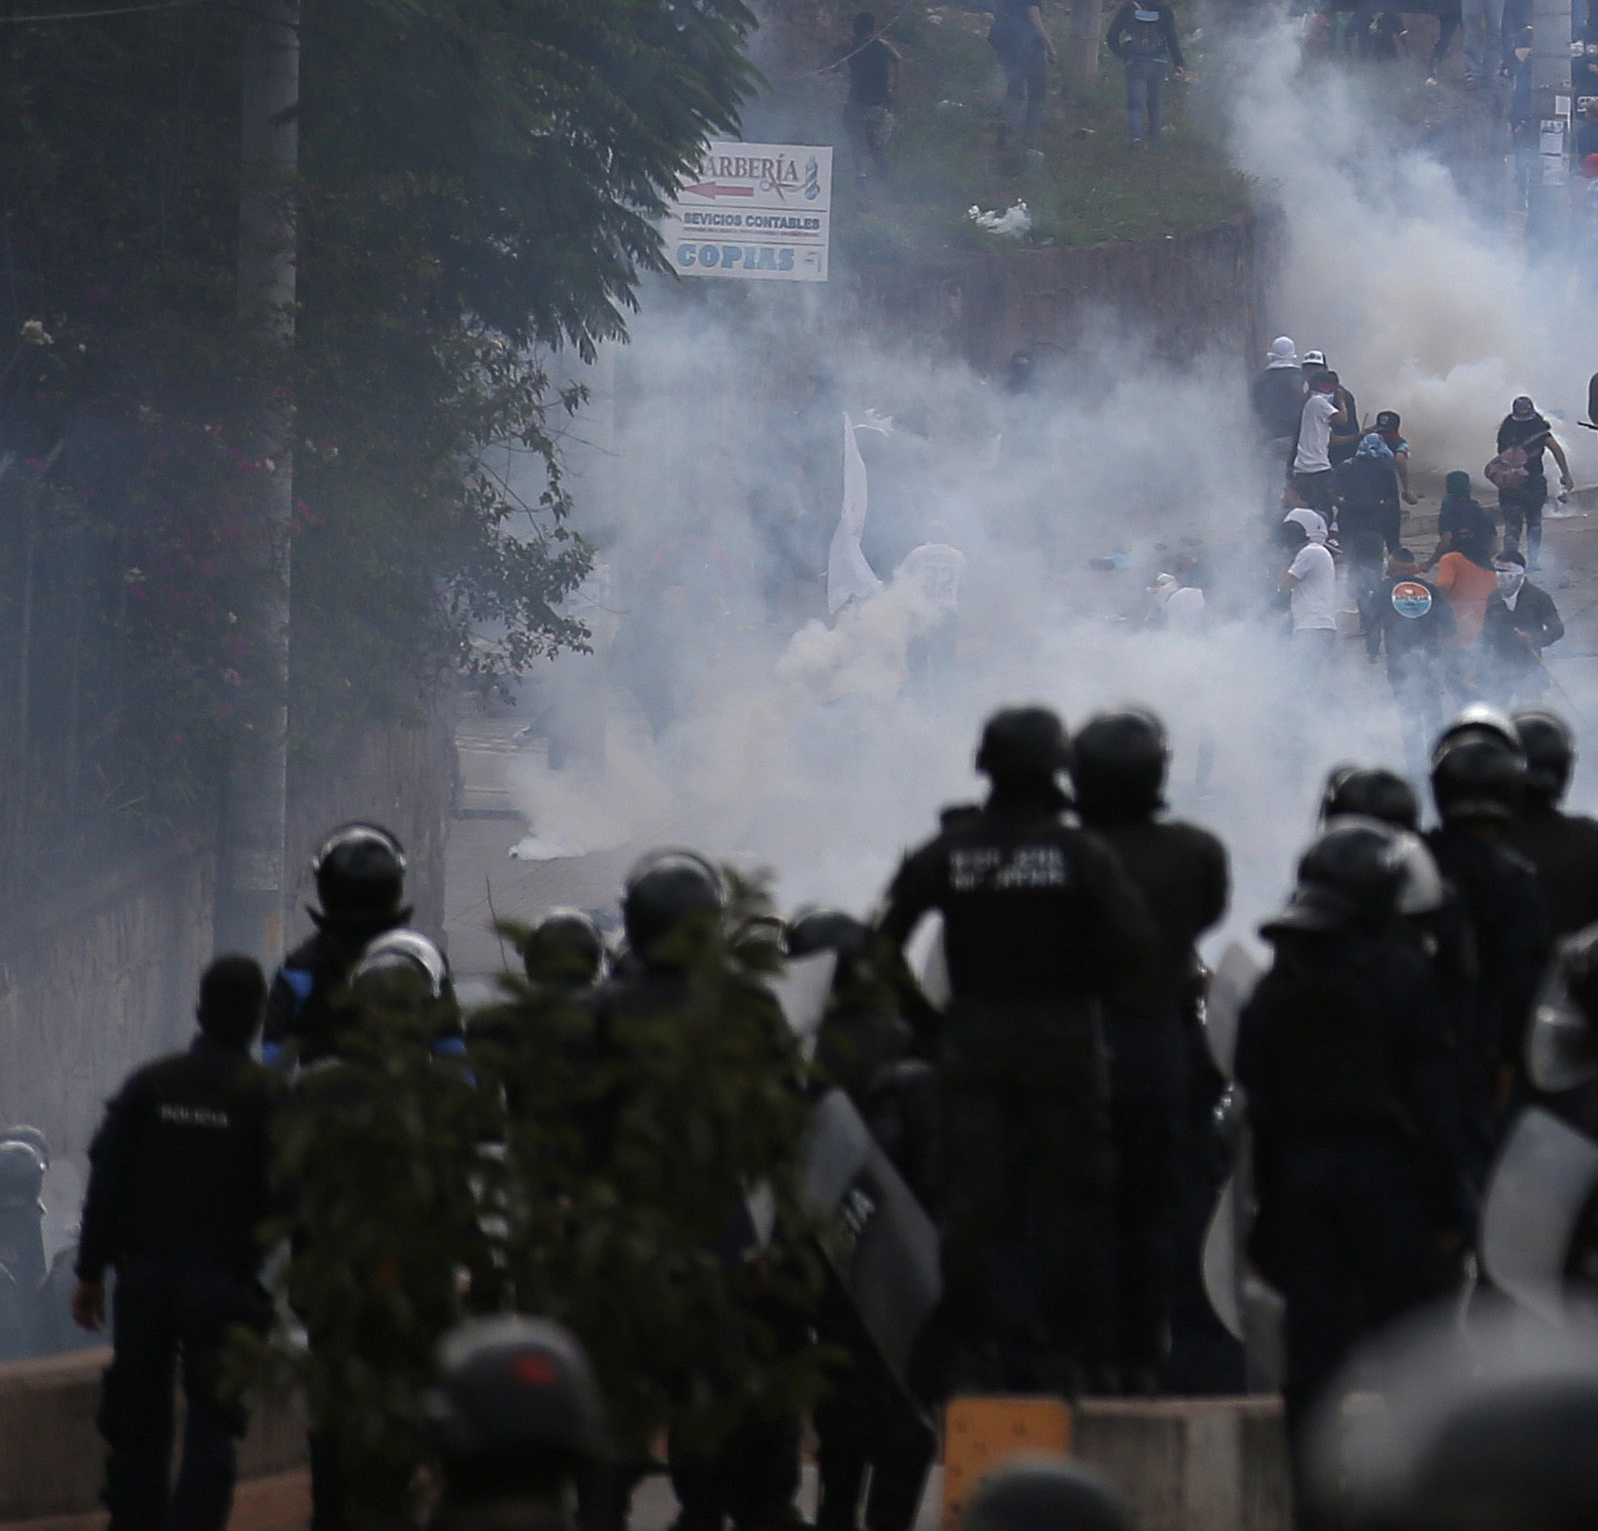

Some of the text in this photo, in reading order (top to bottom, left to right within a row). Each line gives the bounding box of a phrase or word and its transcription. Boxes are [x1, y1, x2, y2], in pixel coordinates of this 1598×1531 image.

[702, 153, 799, 182] ARBERÍA
[745, 215, 820, 231] CONTABLES
[677, 244, 795, 271] COPIAS
